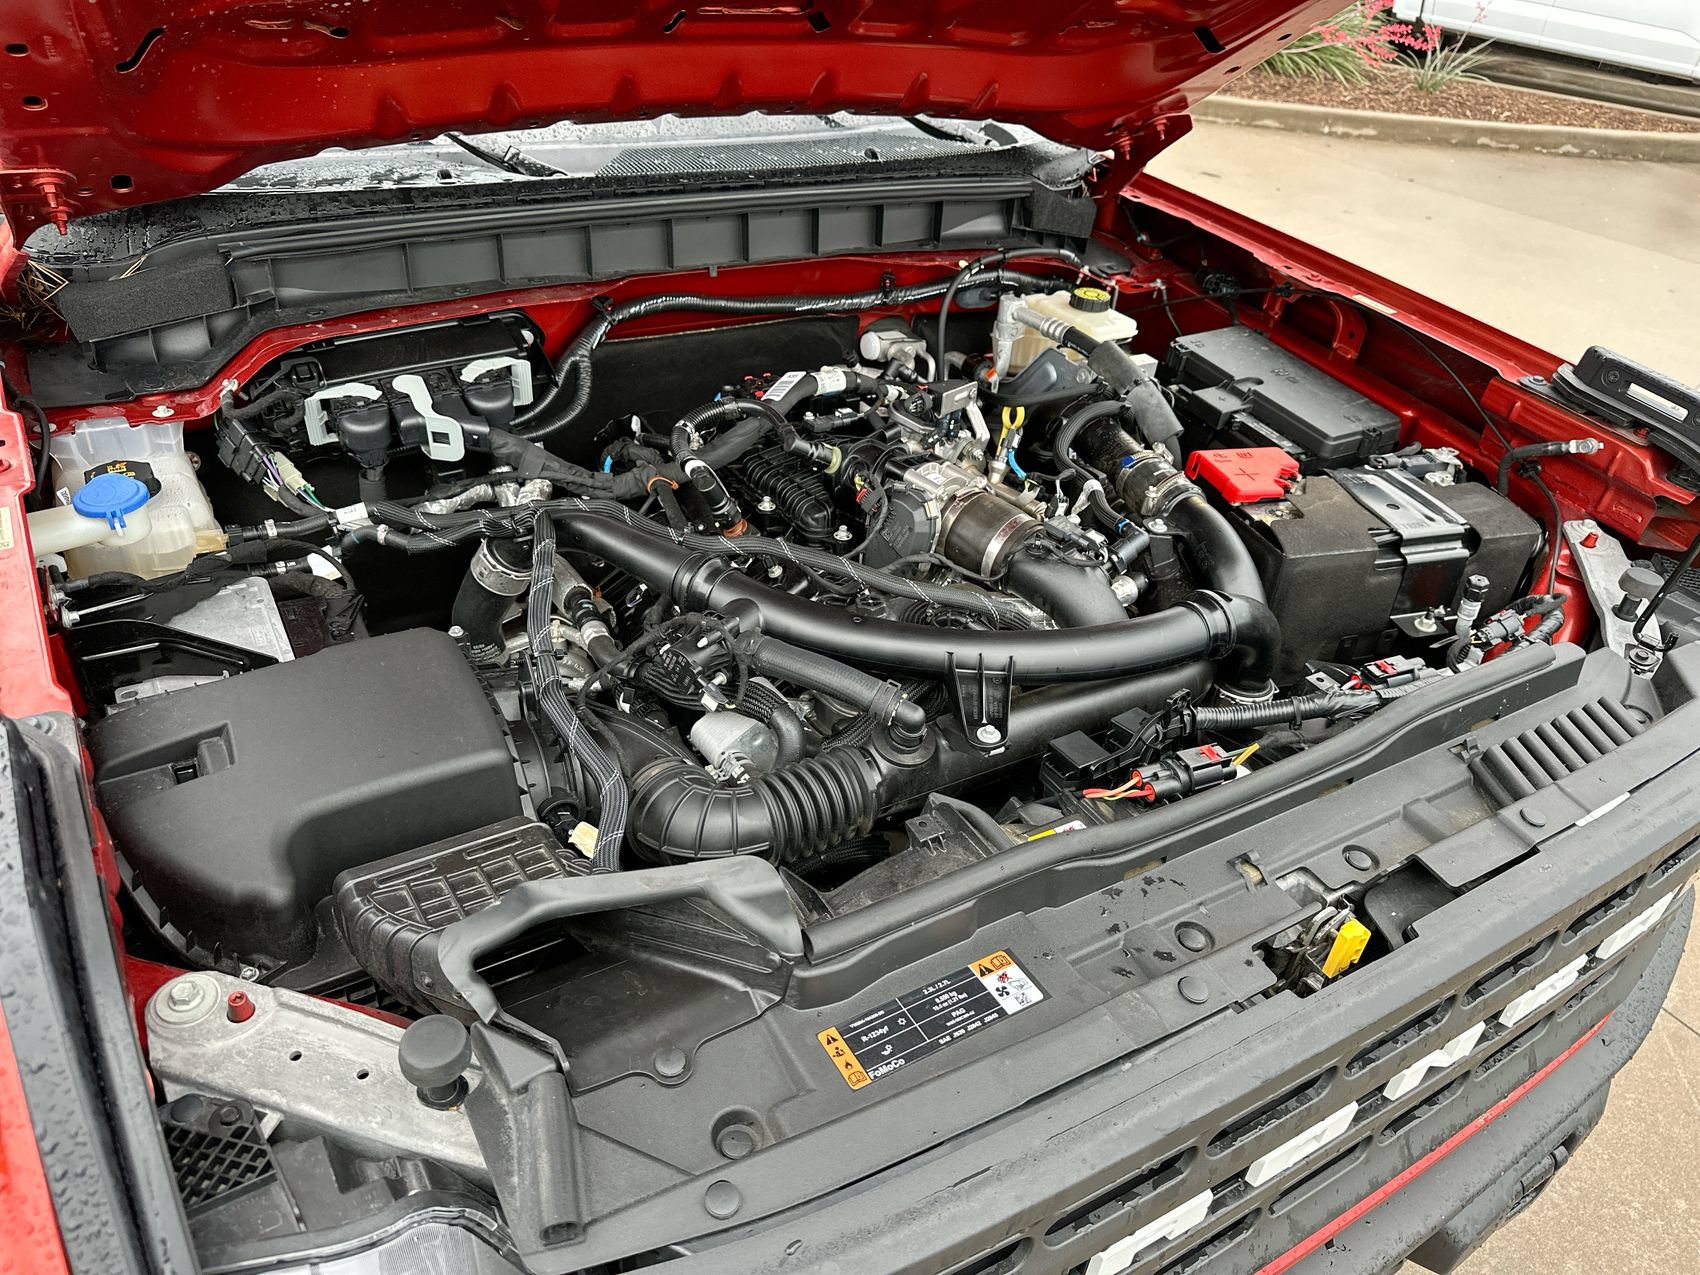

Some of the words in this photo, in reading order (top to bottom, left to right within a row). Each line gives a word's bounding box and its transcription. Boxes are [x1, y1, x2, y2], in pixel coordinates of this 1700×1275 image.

[922, 986, 936, 995] 2.3L
[938, 979, 952, 988] 2.7L
[951, 1007, 966, 1018] PAG
[860, 1025, 889, 1043] R-1234yf
[938, 1034, 952, 1045] SAE
[867, 1057, 906, 1080] FoMoCo
